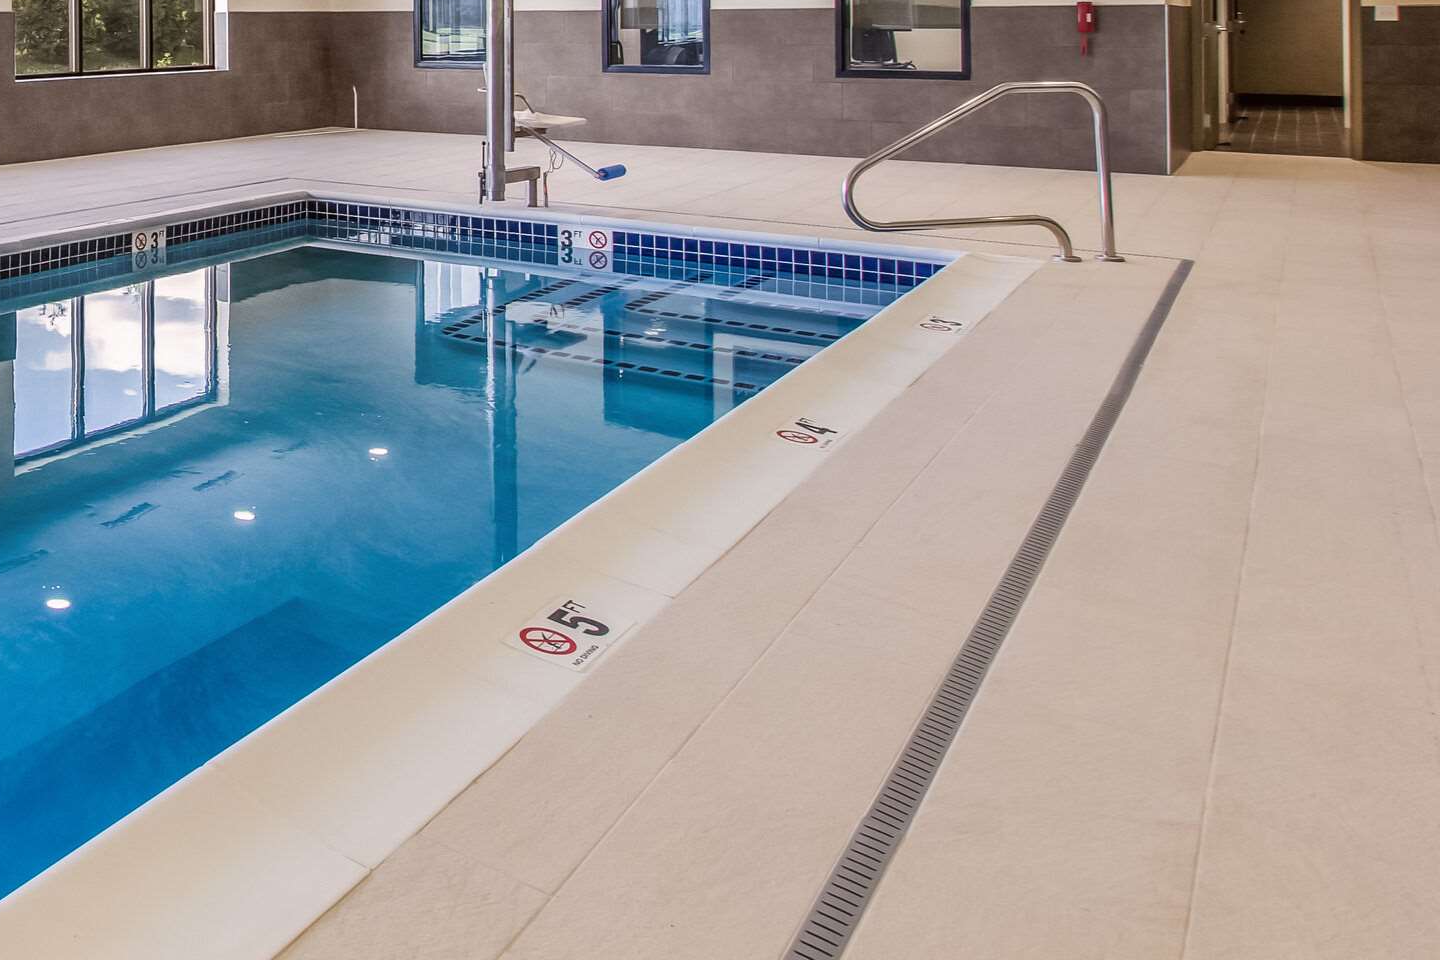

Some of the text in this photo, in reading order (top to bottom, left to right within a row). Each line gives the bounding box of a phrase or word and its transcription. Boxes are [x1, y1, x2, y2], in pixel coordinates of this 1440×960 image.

[151, 232, 159, 249] 3
[561, 230, 583, 249] 3 FT
[547, 600, 610, 637] 5 FT
[571, 644, 599, 666] NO DIVING
